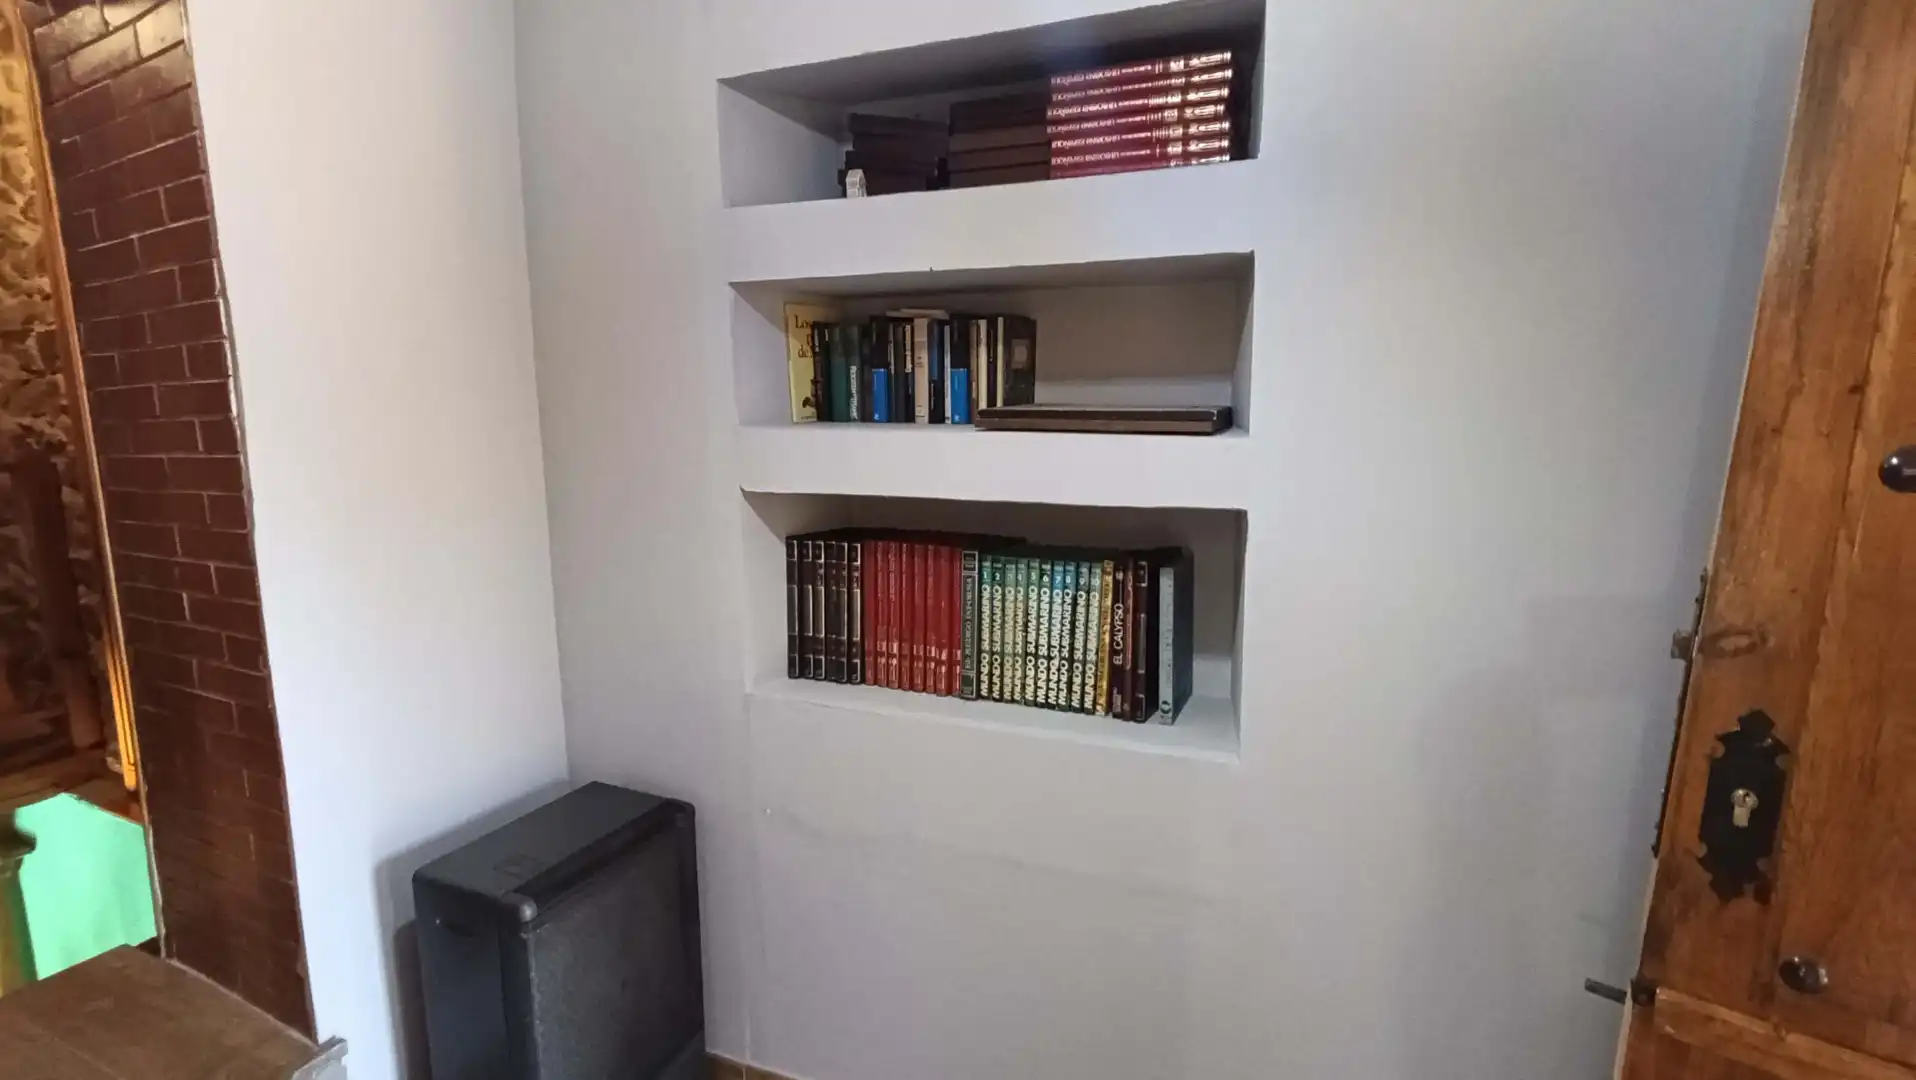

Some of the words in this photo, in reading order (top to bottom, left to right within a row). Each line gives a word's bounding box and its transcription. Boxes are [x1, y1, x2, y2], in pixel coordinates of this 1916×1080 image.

[981, 584, 990, 651] SUBMARINO
[992, 584, 1002, 652] SUBMARINO
[1004, 586, 1015, 654] SUBMARINO
[1016, 587, 1024, 653] SUBMARINO
[1027, 585, 1037, 653] SUBMARINO
[1038, 588, 1051, 657] SUBMARINO
[1050, 589, 1062, 657] SUBMARINO
[1061, 589, 1073, 658] SUBMARINO
[1074, 591, 1085, 660] SUBMARINO
[1086, 591, 1099, 661] SUBMARINO
[1113, 603, 1124, 650] CALYPSO
[980, 653, 989, 697] MUNDO
[992, 655, 1001, 699] MUNDO
[1003, 656, 1013, 700] MUNDO
[1013, 657, 1022, 700] MUNDO
[1025, 656, 1035, 701] MUNDO
[1036, 659, 1048, 703] MUNDO
[1047, 660, 1059, 705] MUNDO
[1113, 654, 1123, 665] EL
[1058, 660, 1069, 706] MUNDO
[1071, 662, 1082, 708] MUNDO
[1083, 663, 1095, 709] MUNDO
